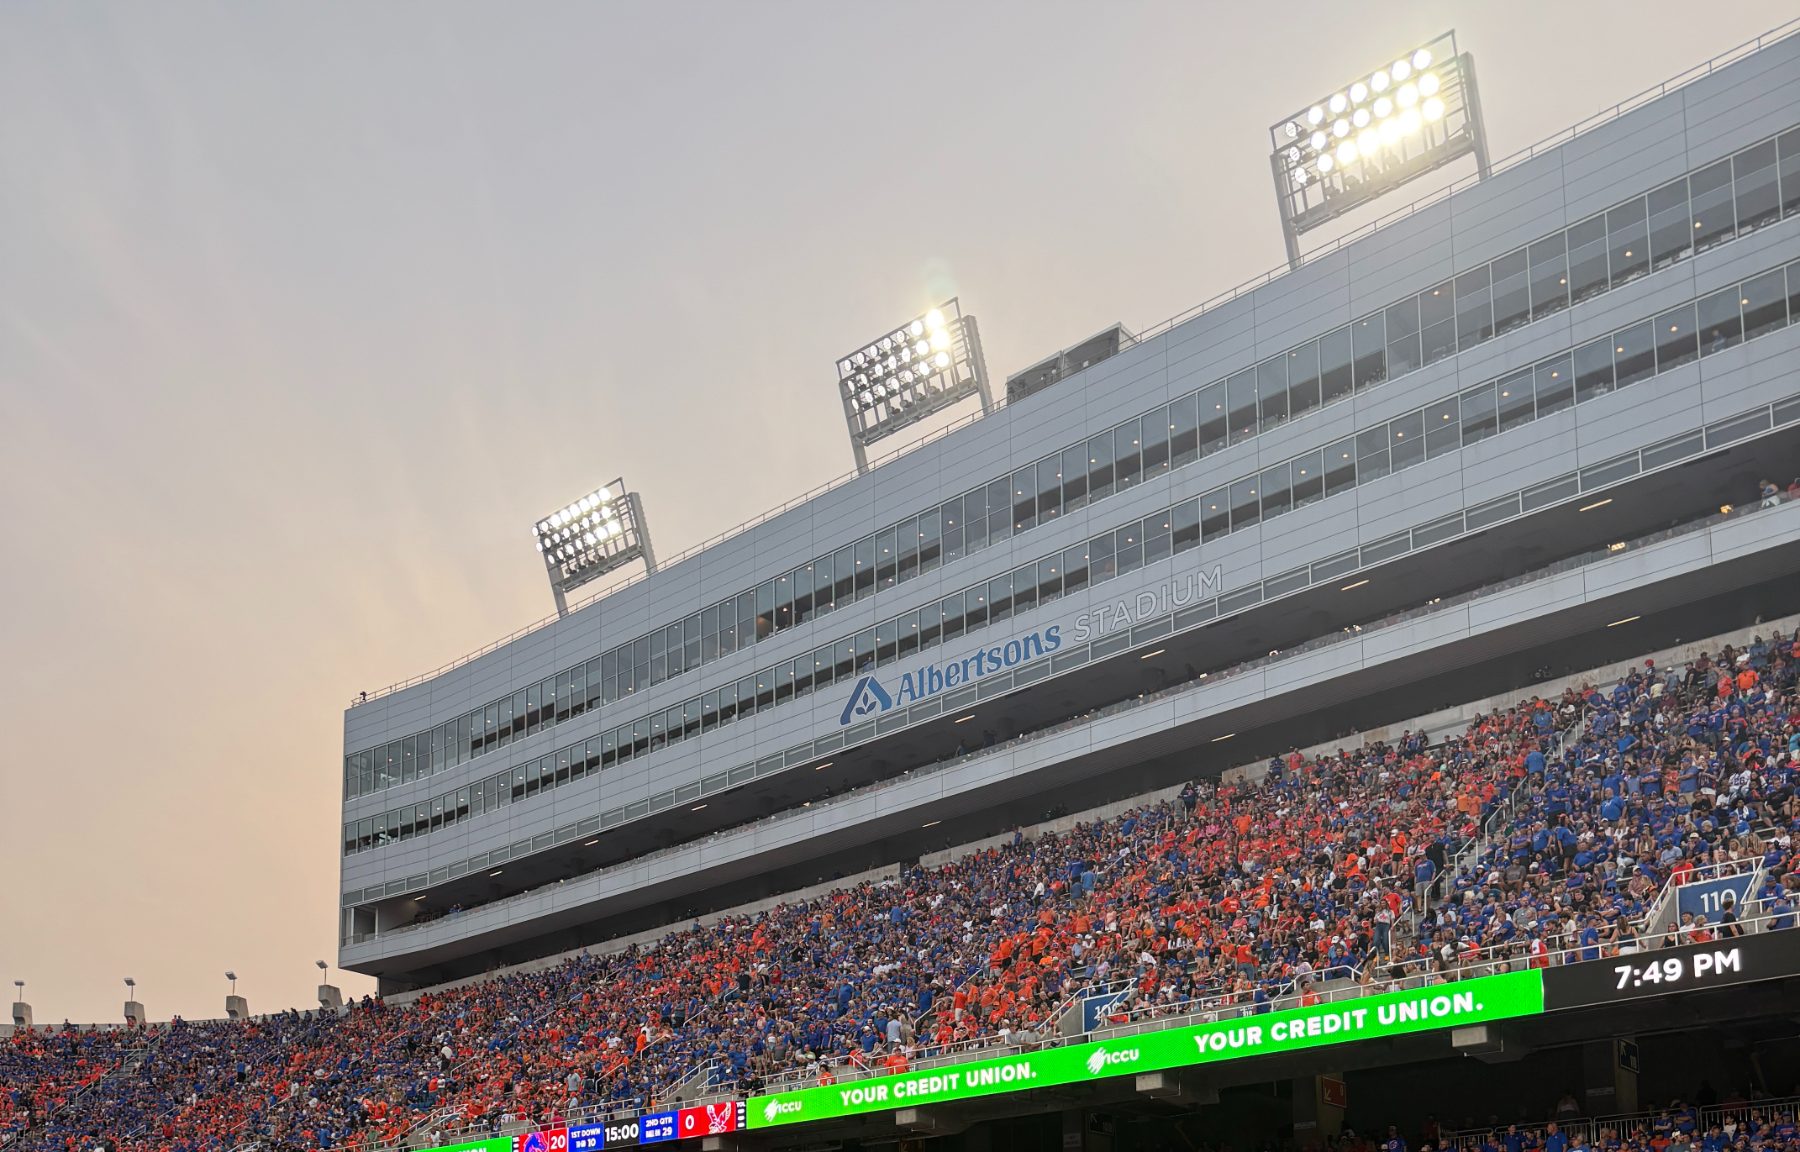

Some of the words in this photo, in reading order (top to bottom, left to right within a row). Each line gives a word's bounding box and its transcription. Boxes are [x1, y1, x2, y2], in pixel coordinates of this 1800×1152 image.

[898, 625, 1062, 706] Albertsons
[1073, 564, 1223, 643] STADIUM
[1614, 957, 1683, 990] 7:49
[1693, 948, 1741, 978] PM
[1193, 1026, 1263, 1053] YOUR
[1270, 1009, 1368, 1042] CREDIT
[1377, 991, 1485, 1025] UNION.
[840, 1086, 888, 1106] YOUR
[894, 1073, 960, 1098] CREDIT
[967, 1061, 1037, 1088] UNION.
[645, 1119, 659, 1127] 2ND
[660, 1116, 673, 1125] QTR
[685, 1114, 695, 1130] 0
[571, 1130, 581, 1139] 1ST
[581, 1127, 601, 1137] DOWN
[604, 1123, 639, 1142] 15:00
[662, 1126, 673, 1137] 29
[551, 1134, 566, 1150] 20
[588, 1138, 597, 1147] 10
